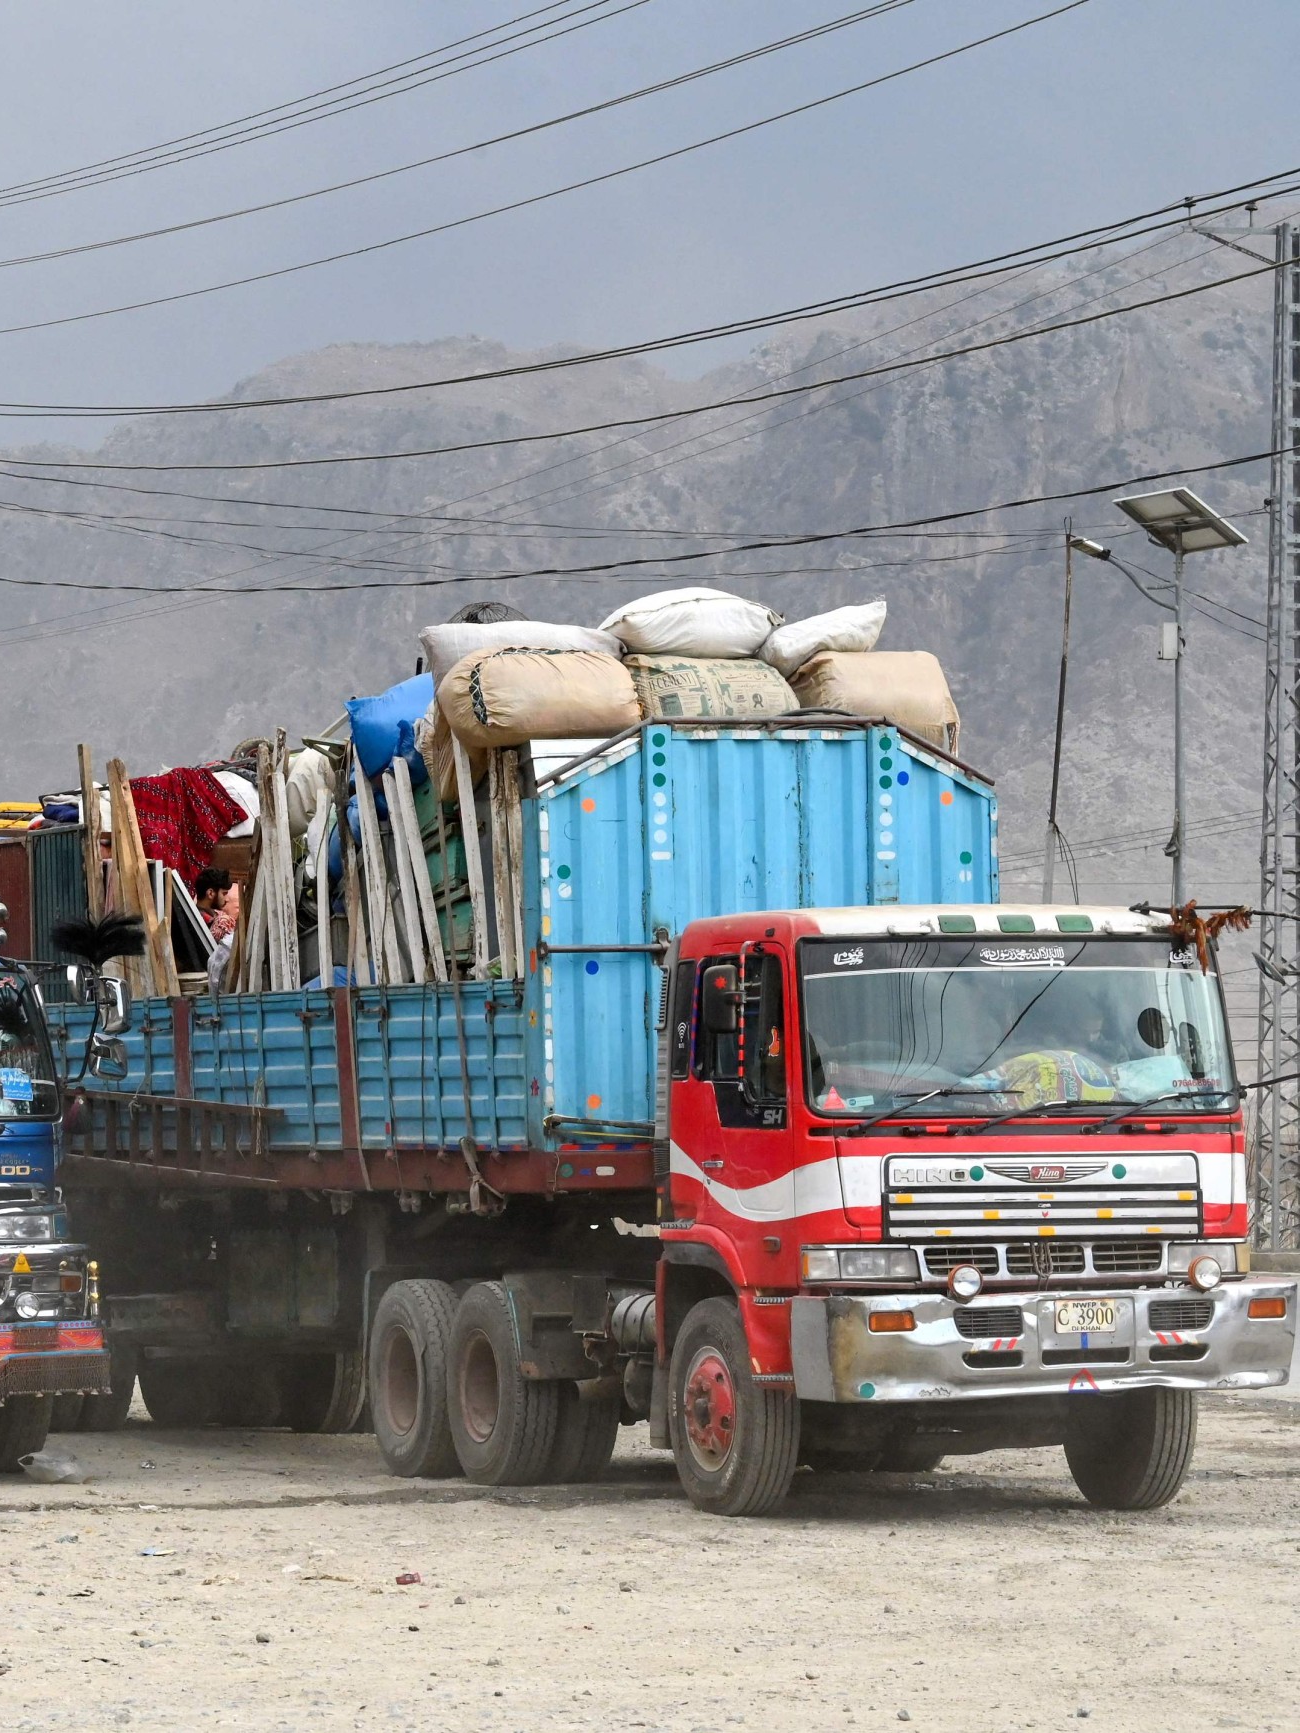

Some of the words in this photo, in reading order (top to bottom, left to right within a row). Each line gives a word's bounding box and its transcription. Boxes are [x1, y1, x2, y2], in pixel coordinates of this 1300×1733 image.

[762, 1109, 783, 1124] SH
[894, 1168, 969, 1183] HINO
[1035, 1167, 1060, 1180] Hino
[1058, 1308, 1070, 1326] C
[1077, 1308, 1114, 1325] 3900
